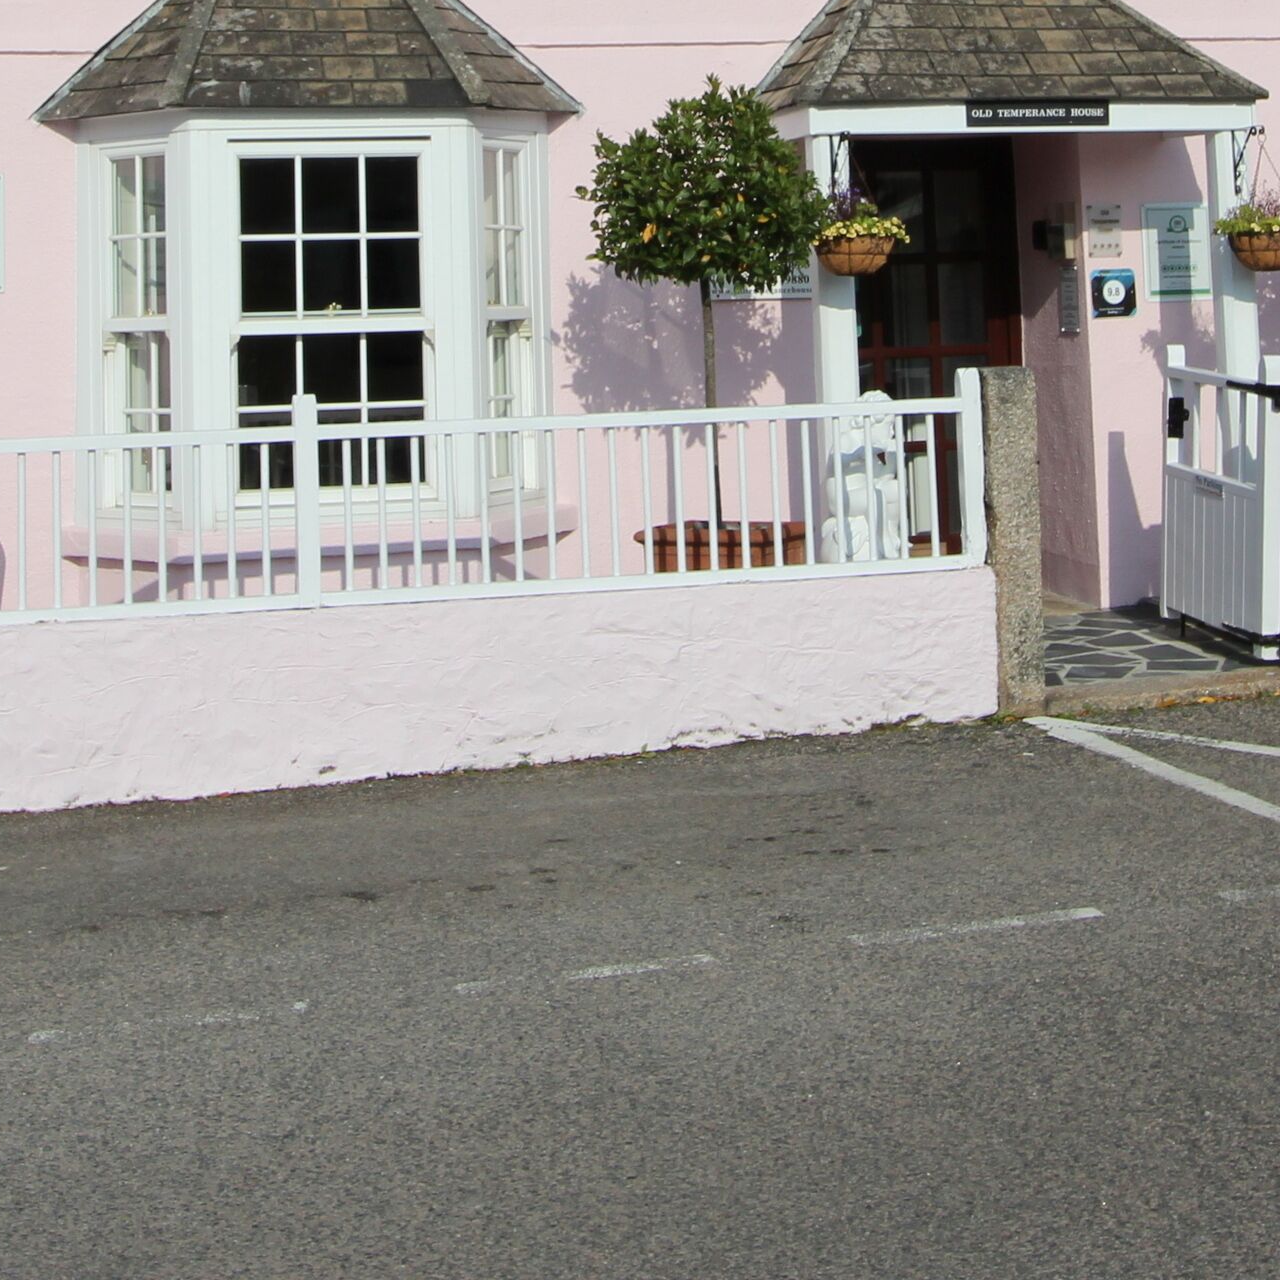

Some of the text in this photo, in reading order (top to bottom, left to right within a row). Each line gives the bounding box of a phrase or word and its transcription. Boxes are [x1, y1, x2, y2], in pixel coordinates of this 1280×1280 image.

[971, 107, 1104, 118] OLD TEMPERANCE HOUSE
[1107, 287, 1121, 297] 9.8
